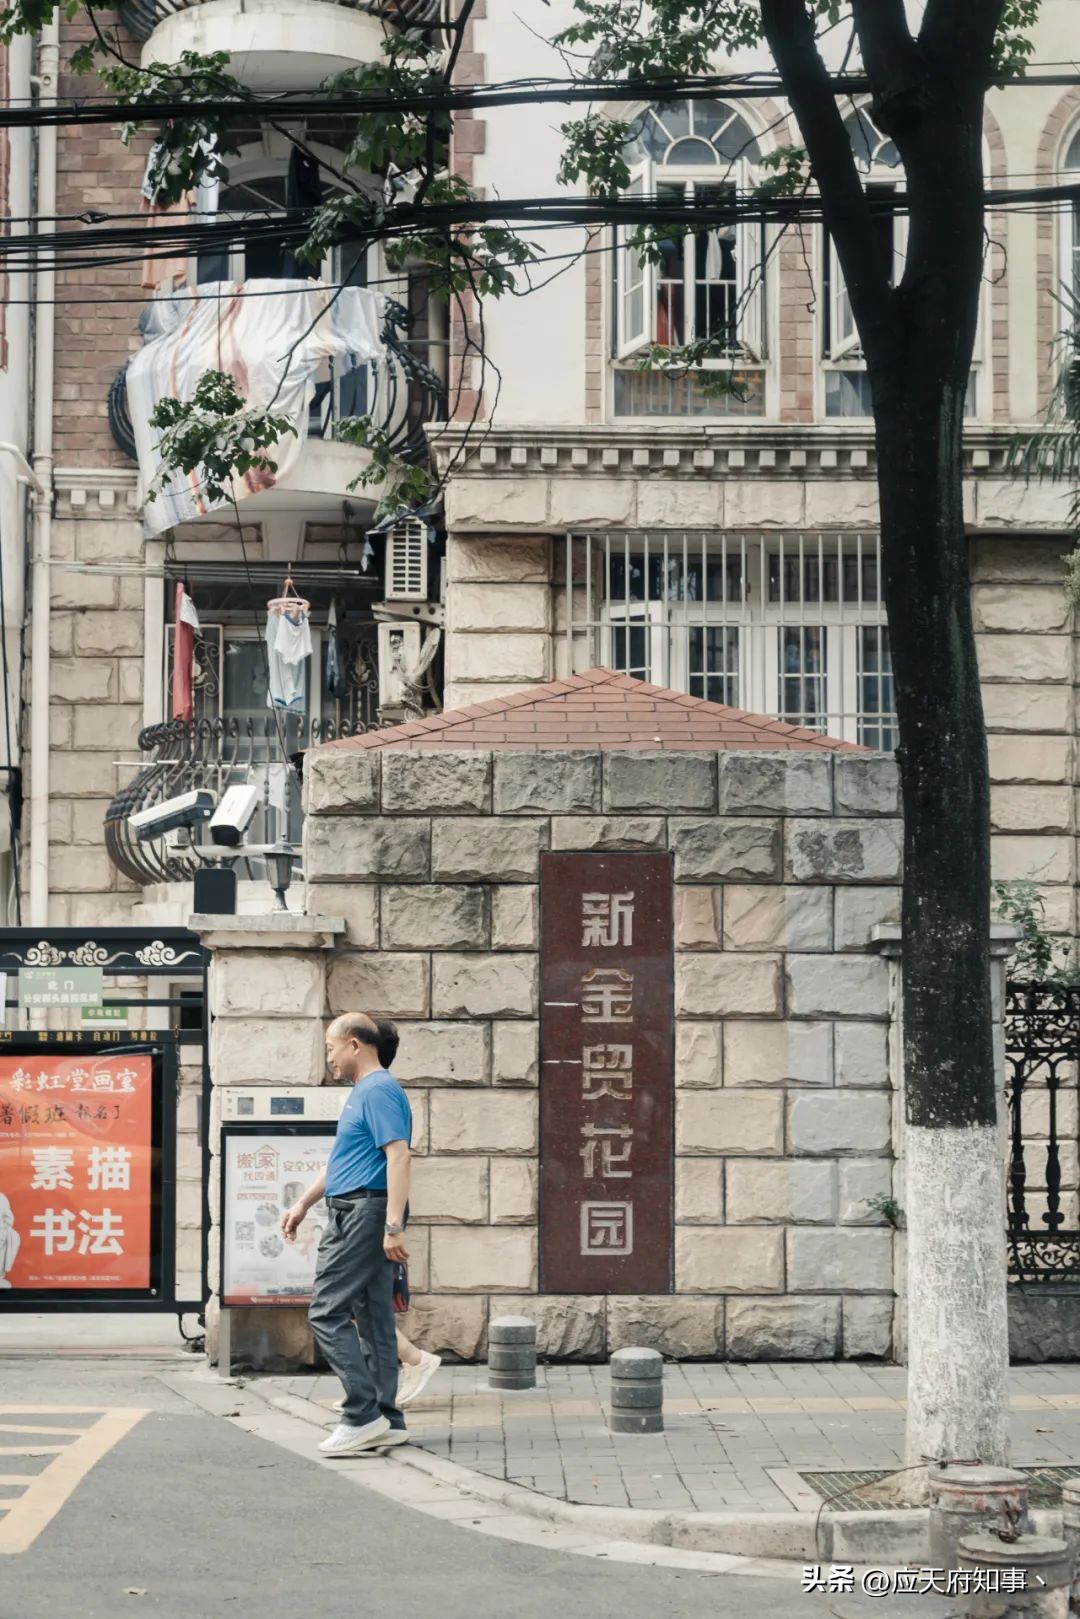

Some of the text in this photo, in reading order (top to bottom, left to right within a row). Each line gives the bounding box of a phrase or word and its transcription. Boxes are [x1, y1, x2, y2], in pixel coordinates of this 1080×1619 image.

[8, 1067, 138, 1093] 彩虹堂画室
[579, 891, 635, 1256] 新金贸花园
[30, 1145, 132, 1191] 素描
[29, 1207, 125, 1256] 书法
